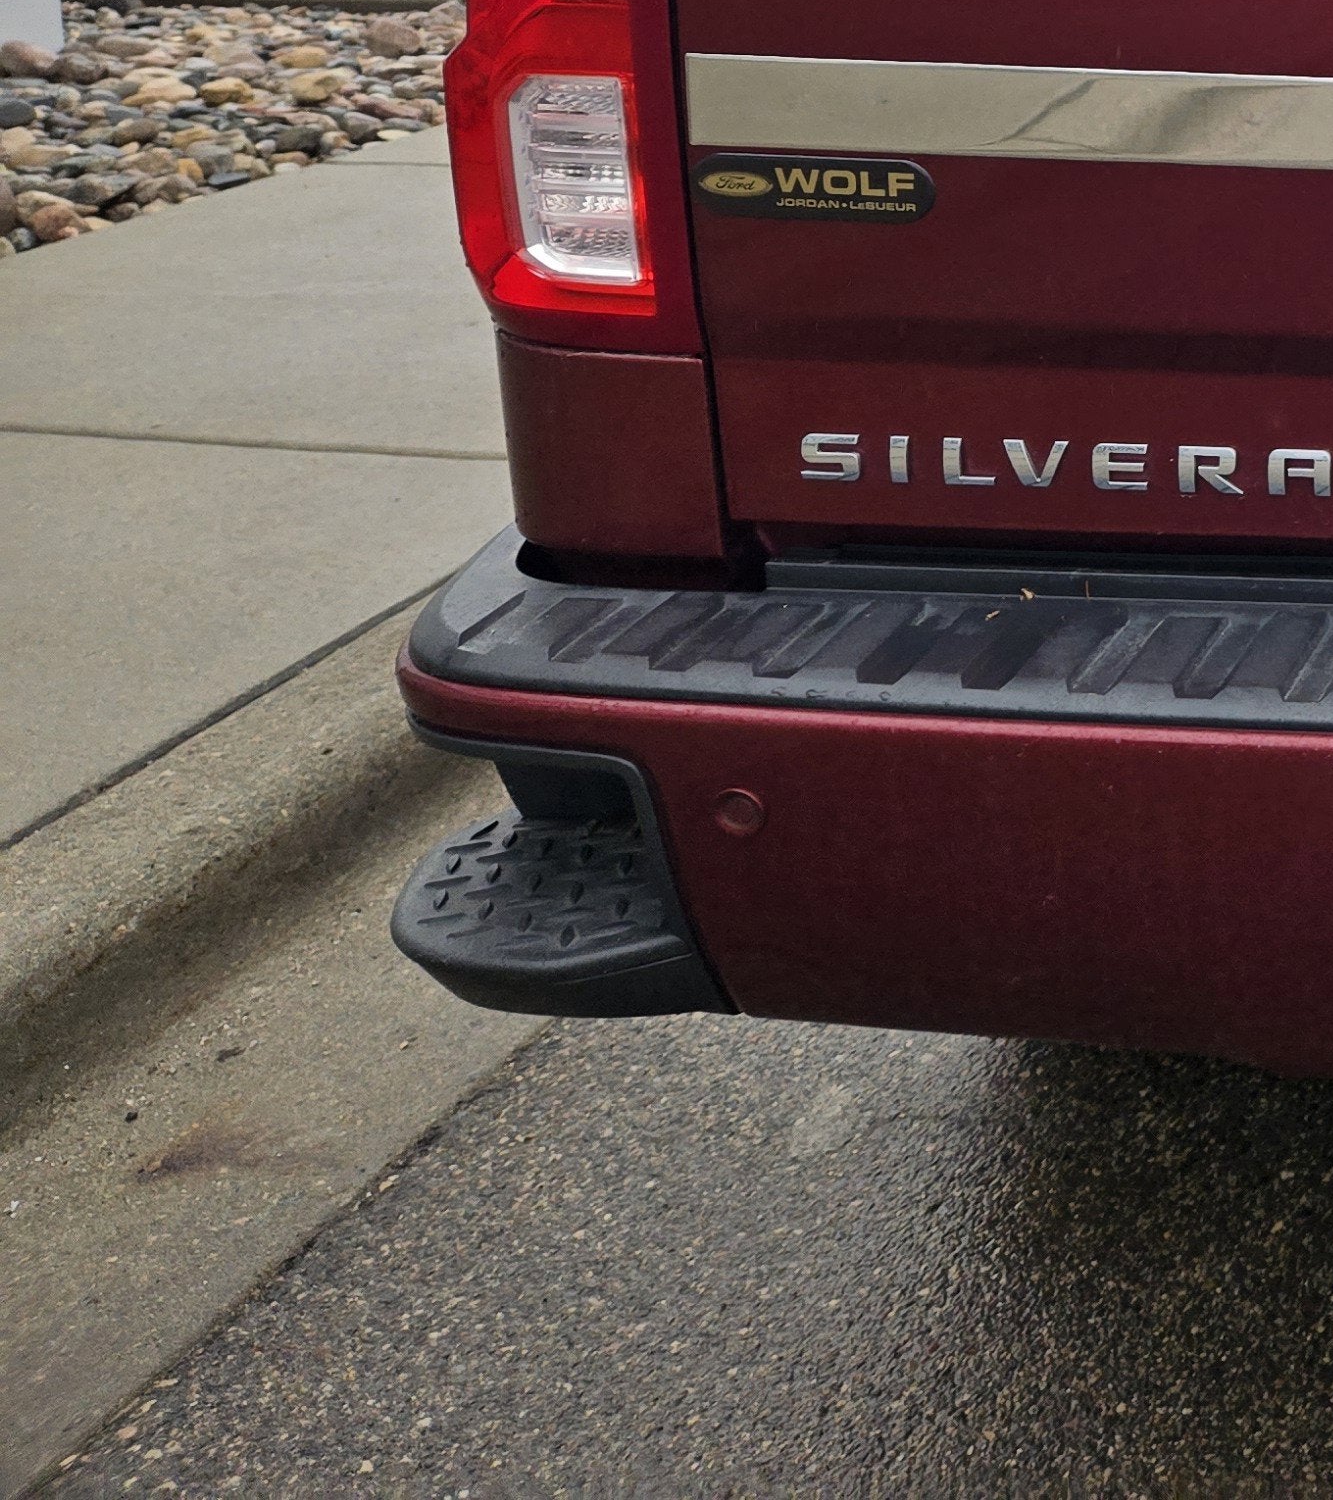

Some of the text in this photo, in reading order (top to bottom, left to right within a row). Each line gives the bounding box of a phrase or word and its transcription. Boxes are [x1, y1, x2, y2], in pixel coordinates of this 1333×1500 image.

[715, 167, 915, 197] Ford WOLF
[776, 198, 840, 209] JORDAN
